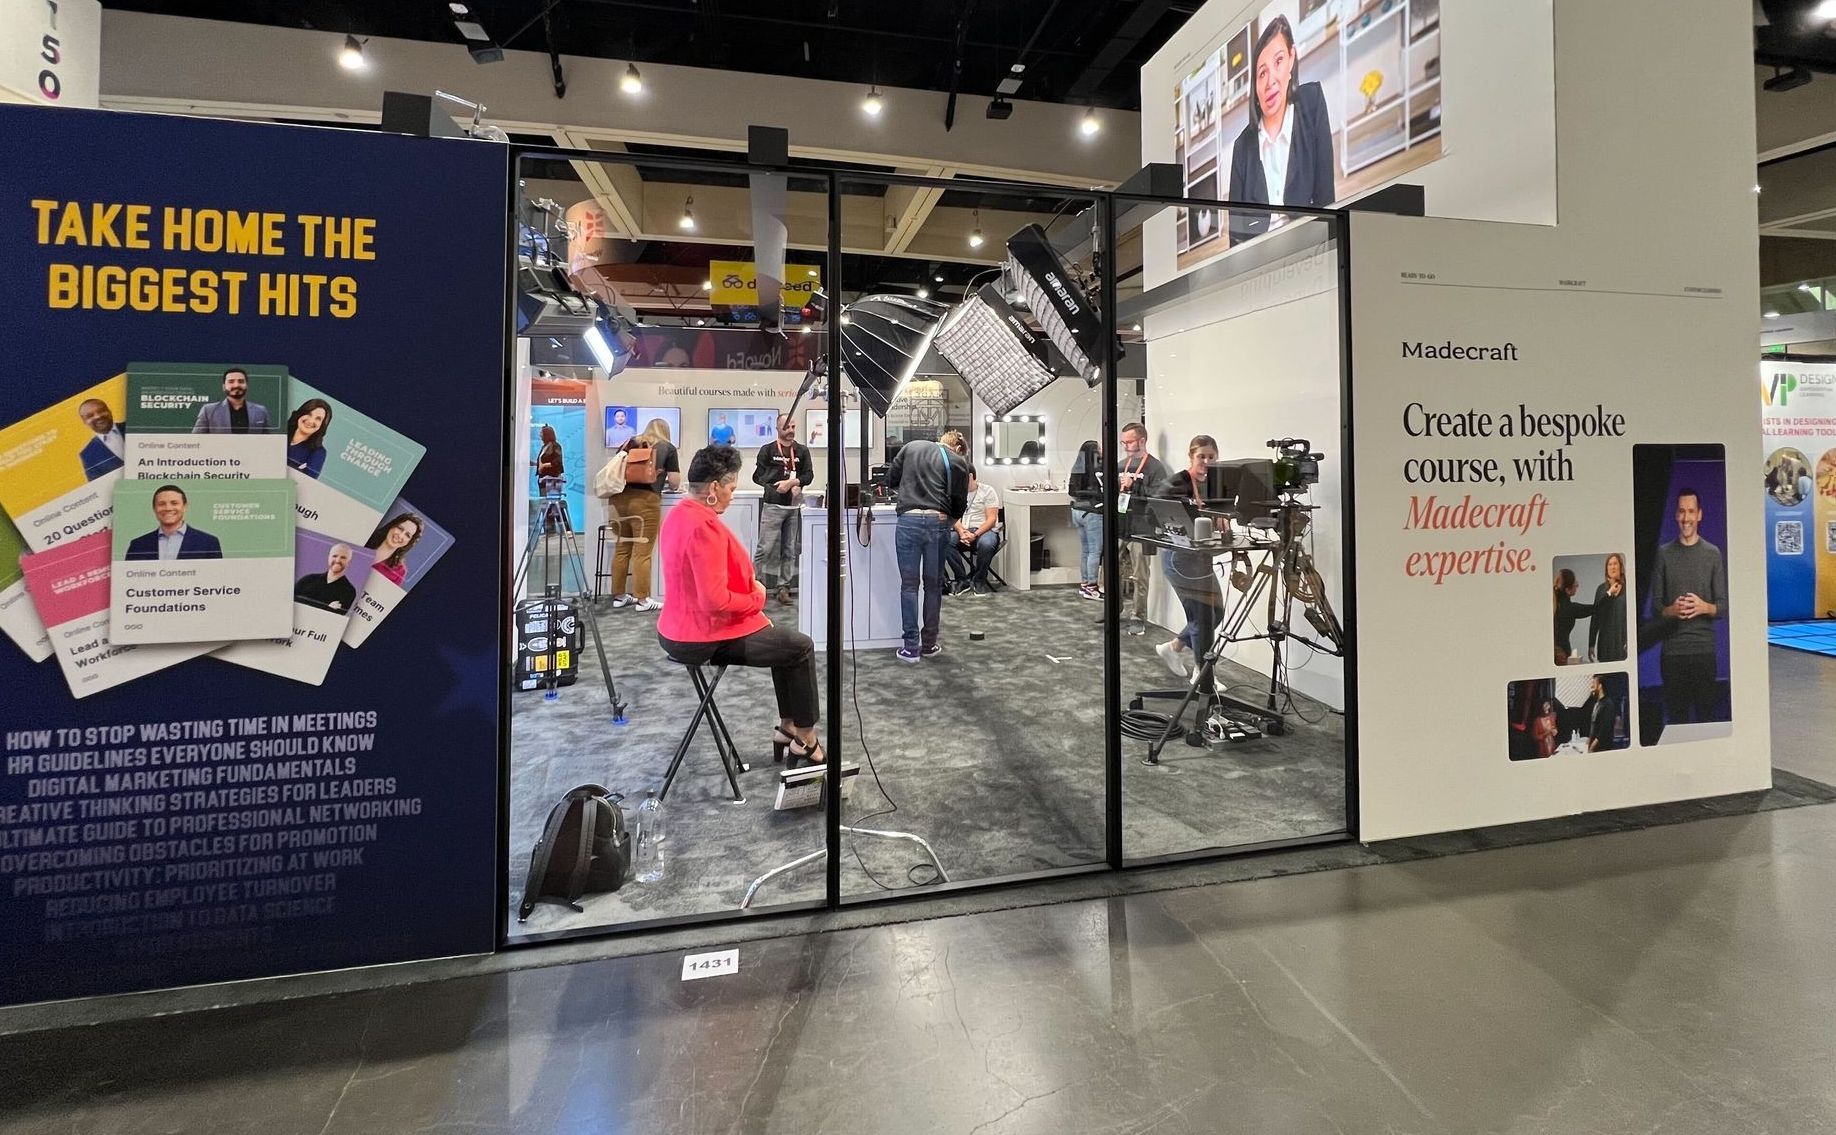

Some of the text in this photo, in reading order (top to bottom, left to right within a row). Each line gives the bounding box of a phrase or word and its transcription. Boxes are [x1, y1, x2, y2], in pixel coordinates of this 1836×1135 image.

[31, 199, 377, 260] TAKE HOME THE
[48, 263, 358, 319] BIGGEST HITS
[1045, 272, 1080, 315] amaran
[1008, 315, 1036, 344] amaran
[1402, 341, 1518, 361] Madecraft
[658, 386, 698, 397] Beautiful
[699, 388, 731, 397] courses
[733, 387, 755, 397] made
[757, 387, 776, 397] with
[1403, 402, 1625, 446] Create a bespoke
[1773, 428, 1814, 436] LEARNING
[167, 442, 201, 450] Content
[344, 445, 393, 474] THROUGH
[349, 438, 392, 464] LEADING
[138, 457, 241, 466] An Introduction to
[340, 452, 382, 477] CHANGE
[1404, 449, 1575, 487] course, with
[138, 471, 200, 480] Blockchain
[63, 492, 99, 514] Content
[1403, 493, 1550, 536] Madecraft
[43, 531, 61, 545] 20
[126, 569, 196, 578] Online Content
[1405, 541, 1536, 585] expertise.
[126, 585, 241, 598] Customer Service
[360, 591, 385, 613] Team
[125, 602, 206, 614] Foundations
[70, 637, 109, 656] Lead a
[307, 630, 327, 643] Full
[6, 711, 377, 750] HOW TO STOP WASTING TIME IN MEETINGS
[8, 733, 375, 774] HR GUIDELINES EVERYONE SHOULD KNOW
[28, 757, 356, 798] DIGITAL MARKETING FUNDAMENTALS
[79, 794, 166, 818] THINKING
[170, 785, 279, 811] STRATEGIES
[283, 783, 316, 802] FOR
[320, 777, 397, 799] LEADERS
[83, 820, 138, 842] GUIDE
[143, 817, 166, 837] TO
[170, 807, 306, 836] PROFESSIONAL
[310, 798, 422, 823] NETWORKING
[1, 824, 377, 873] OVERCOMING OBSTACLES FOR PROMOTION
[165, 855, 283, 883] PRIORITIZING
[287, 852, 308, 871] AT
[313, 847, 365, 869] WORK
[144, 883, 240, 909] EMPLOYEE
[243, 872, 336, 899] TURNOVER
[689, 958, 731, 970] 1431
